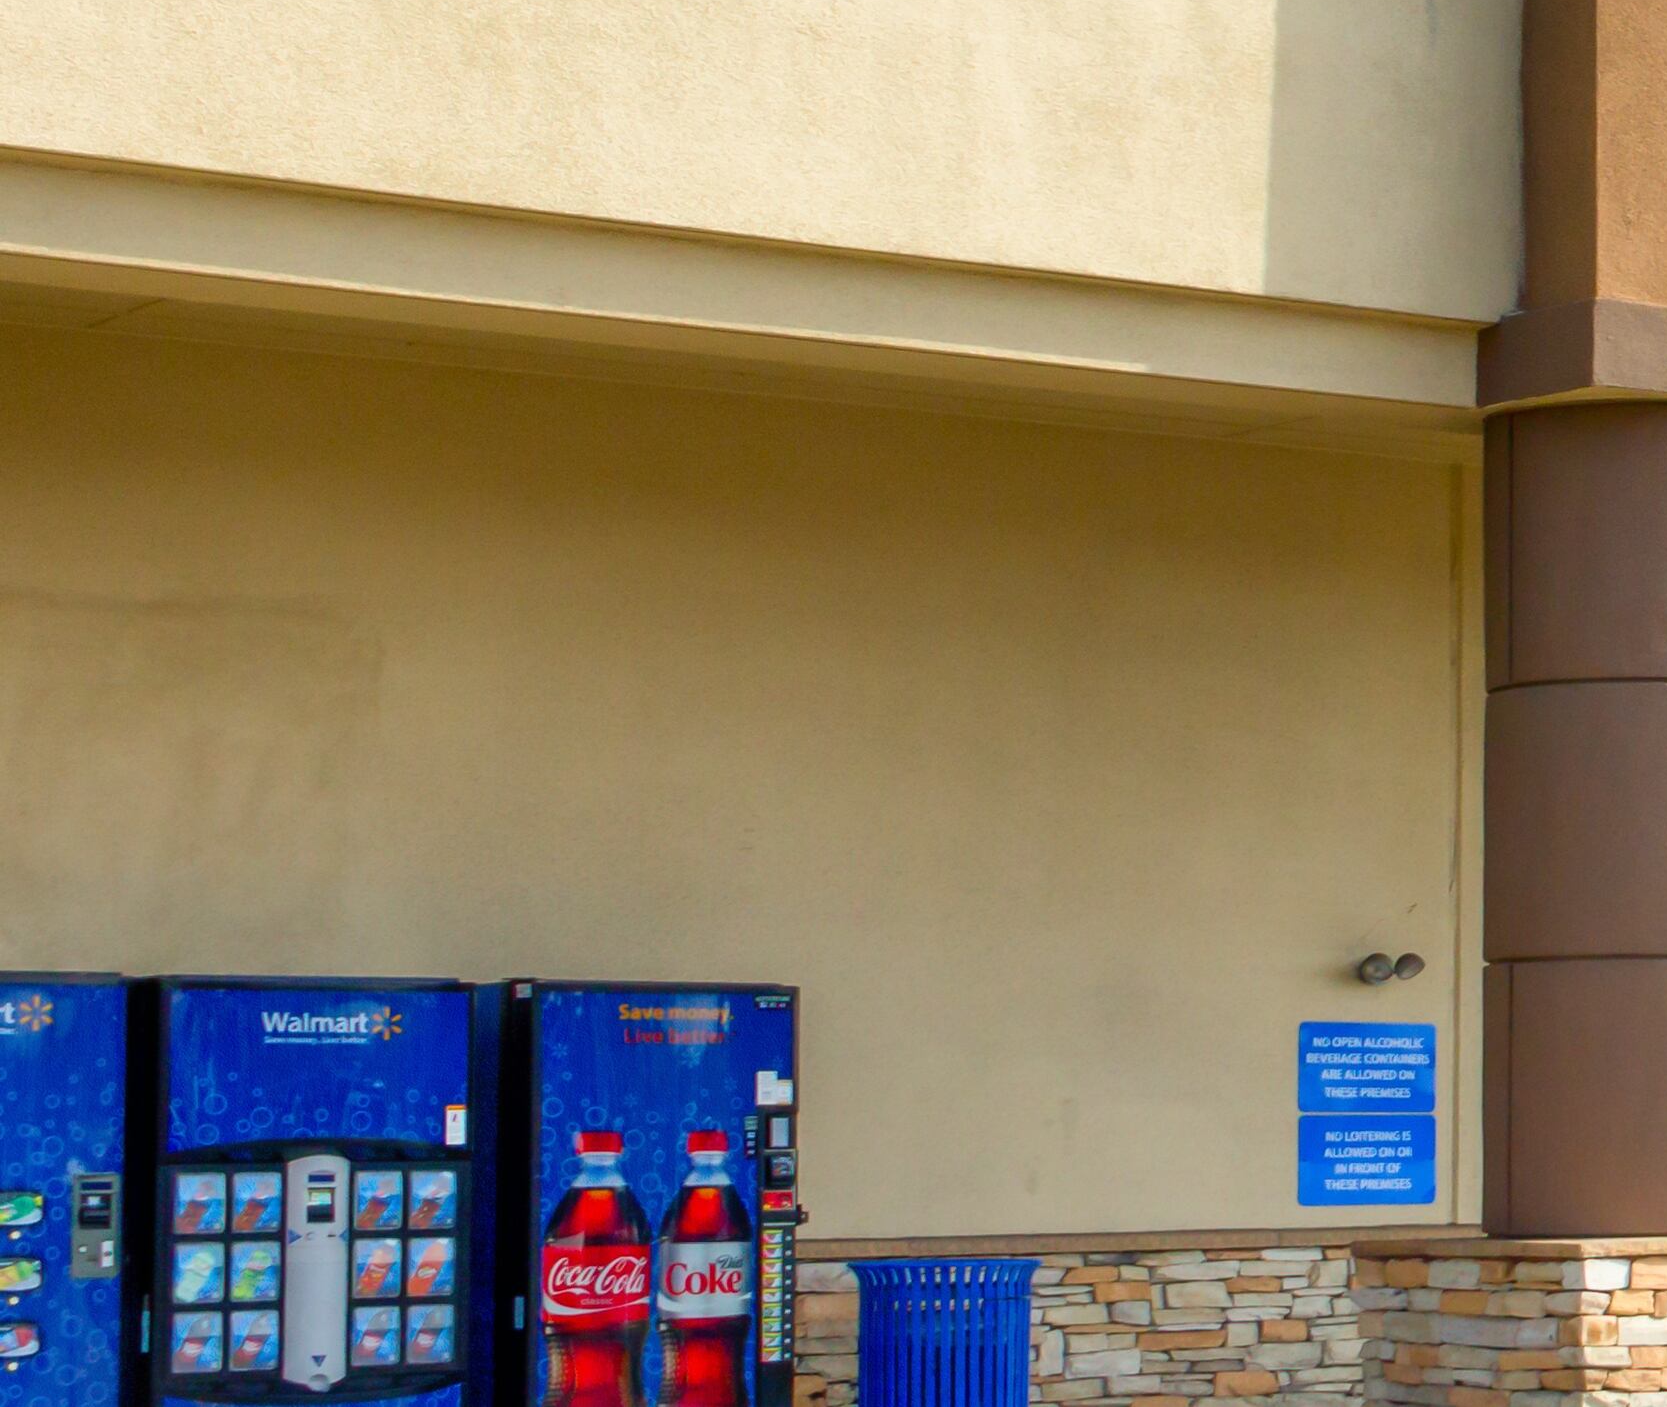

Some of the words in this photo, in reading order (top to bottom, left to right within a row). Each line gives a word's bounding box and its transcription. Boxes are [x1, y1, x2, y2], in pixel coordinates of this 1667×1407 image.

[618, 1003, 664, 1020] Save
[261, 1011, 369, 1033] Walmart
[624, 1027, 664, 1043] Live
[1312, 1037, 1331, 1047] NO
[1332, 1037, 1361, 1048] OPEN
[1363, 1037, 1425, 1048] ALCOHOLIC
[1306, 1052, 1362, 1064] BEVERAGE
[1363, 1053, 1430, 1065] CONTAINERS
[1321, 1069, 1343, 1080] ARE
[1344, 1069, 1397, 1081] ALLOWED
[1399, 1069, 1416, 1080] ON
[1324, 1087, 1358, 1098] THESE
[1360, 1087, 1412, 1099] PREMISES
[1325, 1131, 1343, 1142] NO
[1344, 1130, 1401, 1142] LOITERING
[1402, 1130, 1412, 1141] IS
[1324, 1146, 1377, 1158] ALLOWED
[1378, 1146, 1395, 1157] ON
[1334, 1163, 1348, 1174] IN
[1348, 1162, 1385, 1173] FRONT
[1385, 1162, 1402, 1173] OF
[1324, 1179, 1359, 1191] THESE
[1360, 1178, 1412, 1190] PREMISES
[548, 1256, 647, 1296] Coca-Cola
[665, 1262, 743, 1296] Coke
